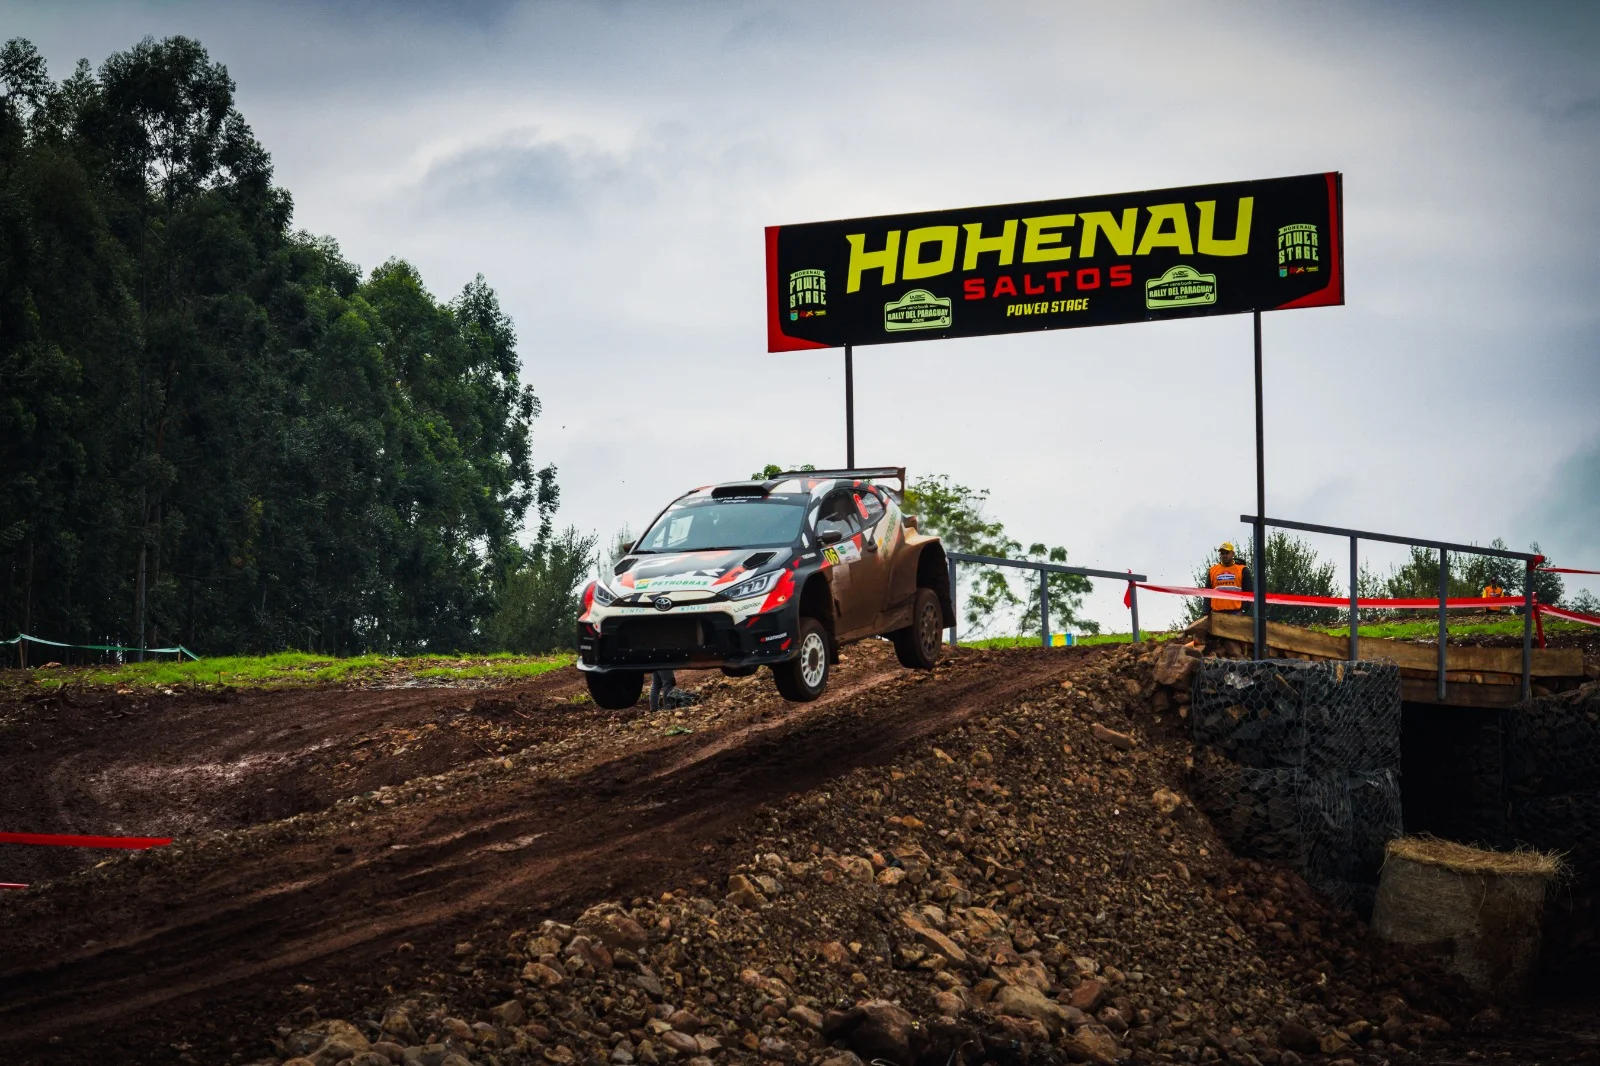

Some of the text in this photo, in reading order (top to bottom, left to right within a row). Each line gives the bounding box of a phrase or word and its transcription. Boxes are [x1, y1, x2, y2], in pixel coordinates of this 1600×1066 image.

[1283, 224, 1312, 232] HOHENAU
[846, 196, 1254, 293] HOHENAU
[1278, 231, 1318, 250] POWER
[1278, 246, 1319, 265] STAGE
[789, 276, 826, 295] POWER
[963, 265, 1133, 300] SALTOS
[1149, 285, 1213, 298] RALLY DEL PARAGUAY
[789, 291, 827, 308] STAGE
[1006, 298, 1089, 317] POWER STAGE
[887, 308, 949, 321] RALLY DEL PARAGUAY
[824, 548, 840, 566] 06
